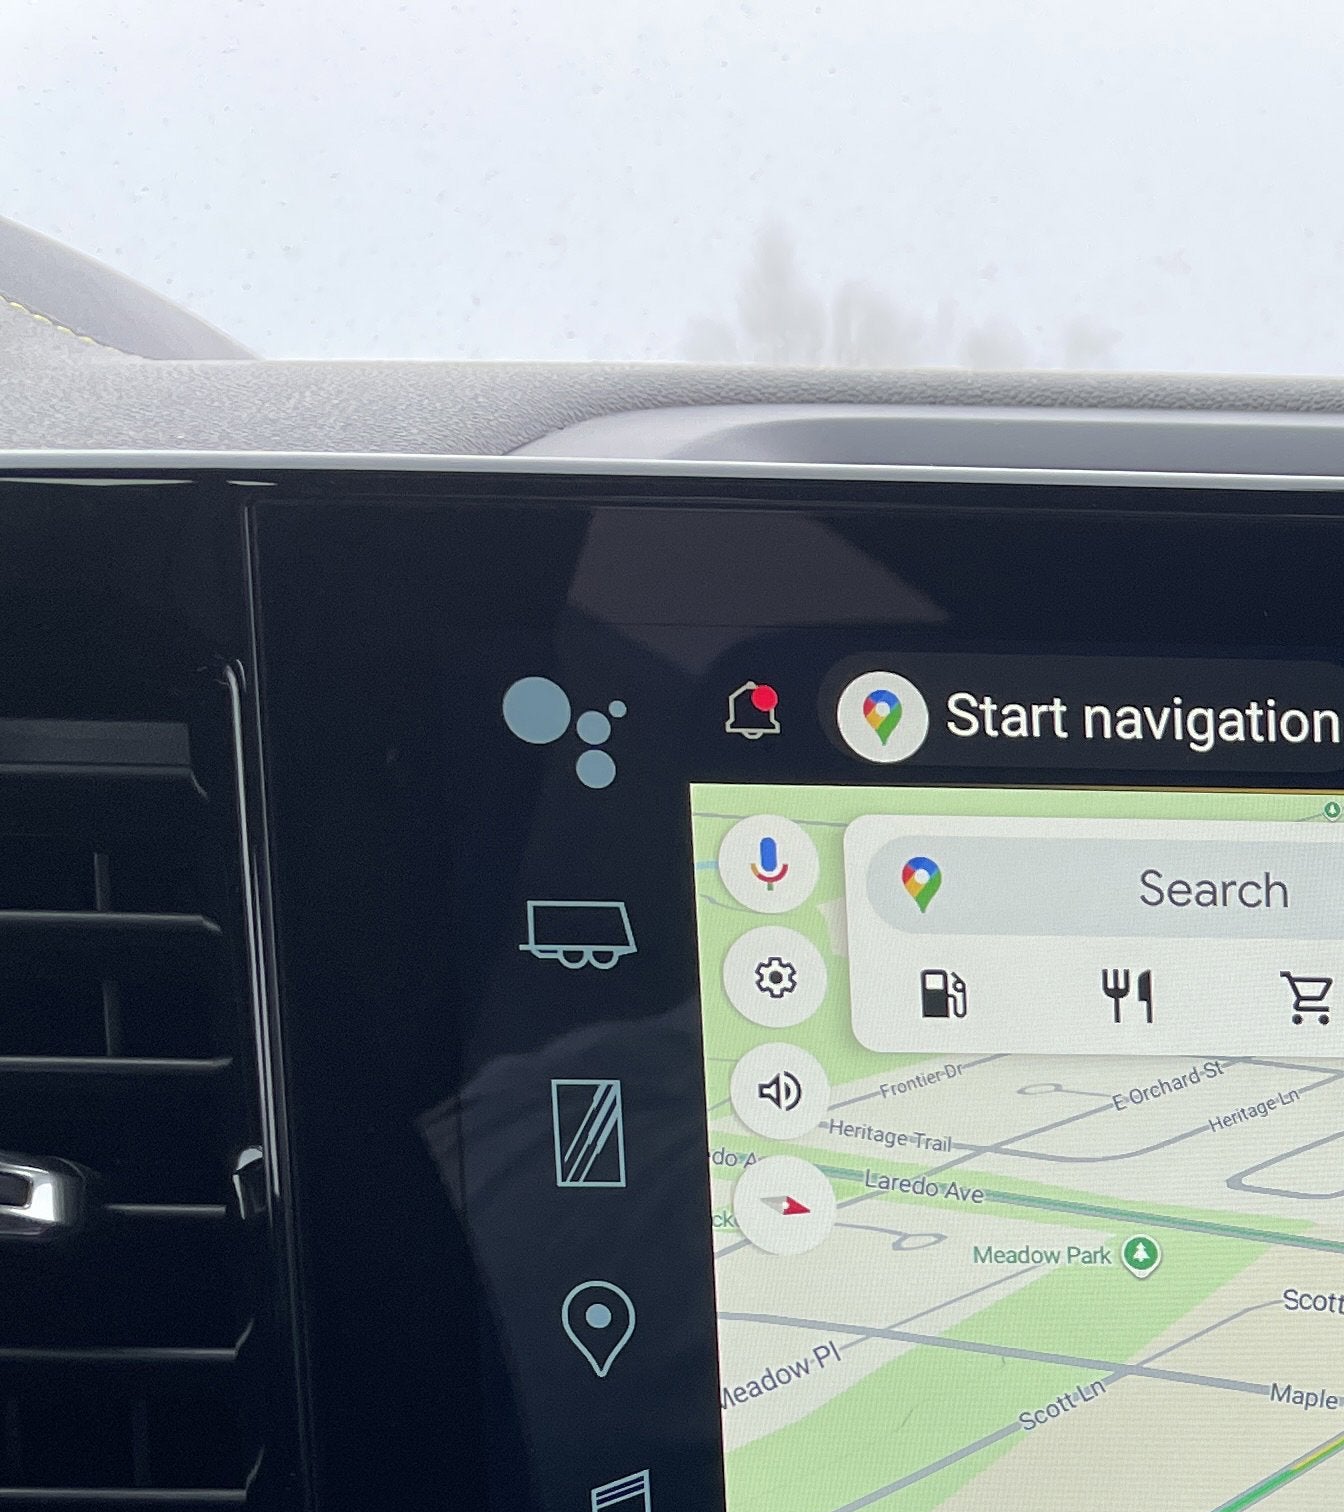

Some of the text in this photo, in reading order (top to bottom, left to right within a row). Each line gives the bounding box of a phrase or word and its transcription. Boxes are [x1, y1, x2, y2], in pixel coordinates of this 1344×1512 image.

[947, 692, 1341, 751] Start navigation
[1140, 869, 1289, 909] Search
[880, 1064, 964, 1099] Frontier Dr
[1112, 1060, 1225, 1112] E Orchard St
[1209, 1088, 1300, 1133] Heritage Ln
[829, 1118, 953, 1153] Heritage Trail
[865, 1169, 984, 1204] Laredo Ave
[973, 1245, 1112, 1265] Meadow Park
[719, 1340, 841, 1410] Meadow Pl
[1018, 1376, 1107, 1433] Scott Ln
[1269, 1383, 1339, 1412] Maple
